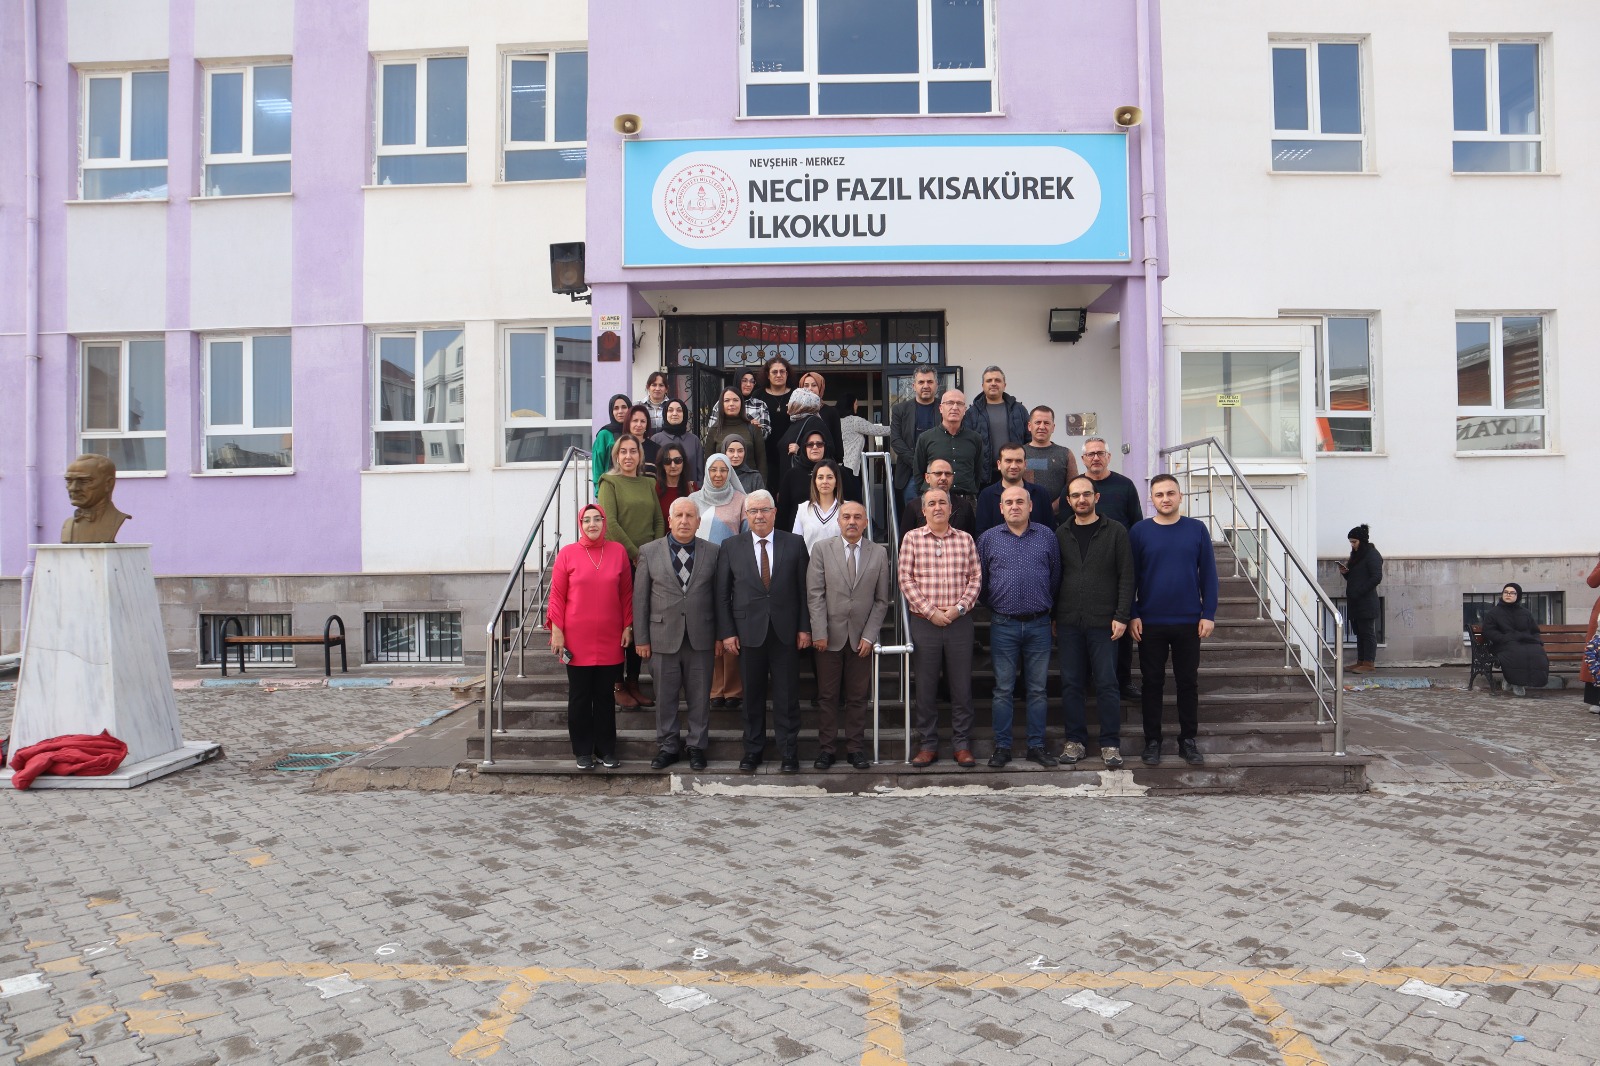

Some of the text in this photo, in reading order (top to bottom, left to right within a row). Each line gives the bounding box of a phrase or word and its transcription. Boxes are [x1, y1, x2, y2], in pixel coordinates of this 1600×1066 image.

[805, 156, 845, 167] MERKEZ
[748, 171, 1075, 203] NECİP FAZIL KISAKÜREK
[749, 210, 886, 239] İLKOKULU
